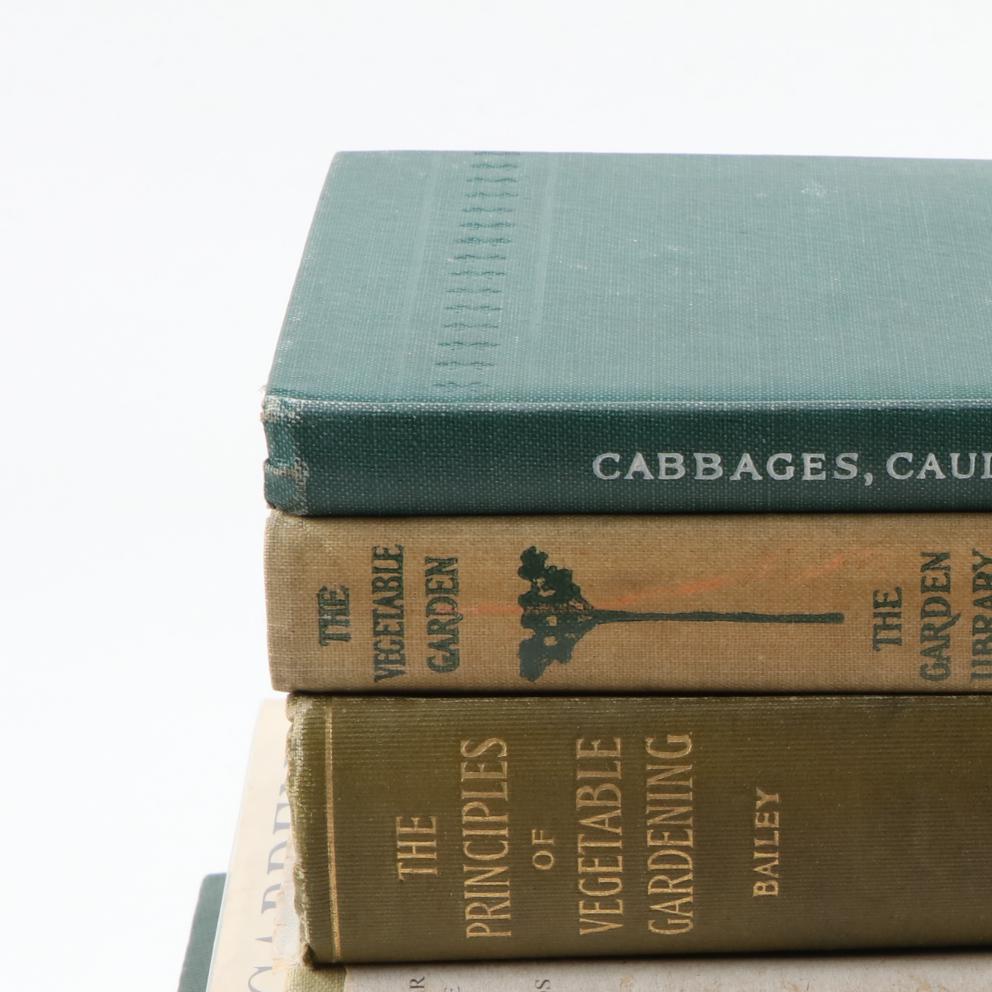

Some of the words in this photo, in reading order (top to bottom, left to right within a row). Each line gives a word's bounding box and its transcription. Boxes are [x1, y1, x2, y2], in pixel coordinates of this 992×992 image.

[592, 452, 874, 486] CABBAGES,
[317, 584, 352, 647] THE
[371, 543, 407, 683] VEGETABLE
[424, 555, 464, 673] GARDEN
[872, 586, 903, 652] THE
[920, 551, 961, 682] GARDEN
[396, 816, 438, 880] THE
[461, 737, 512, 938] PRINCIPLES
[532, 828, 556, 870] OF
[576, 736, 624, 935] VEGETABLE
[646, 732, 694, 936] GARDENING
[753, 787, 781, 898] BAILEY
